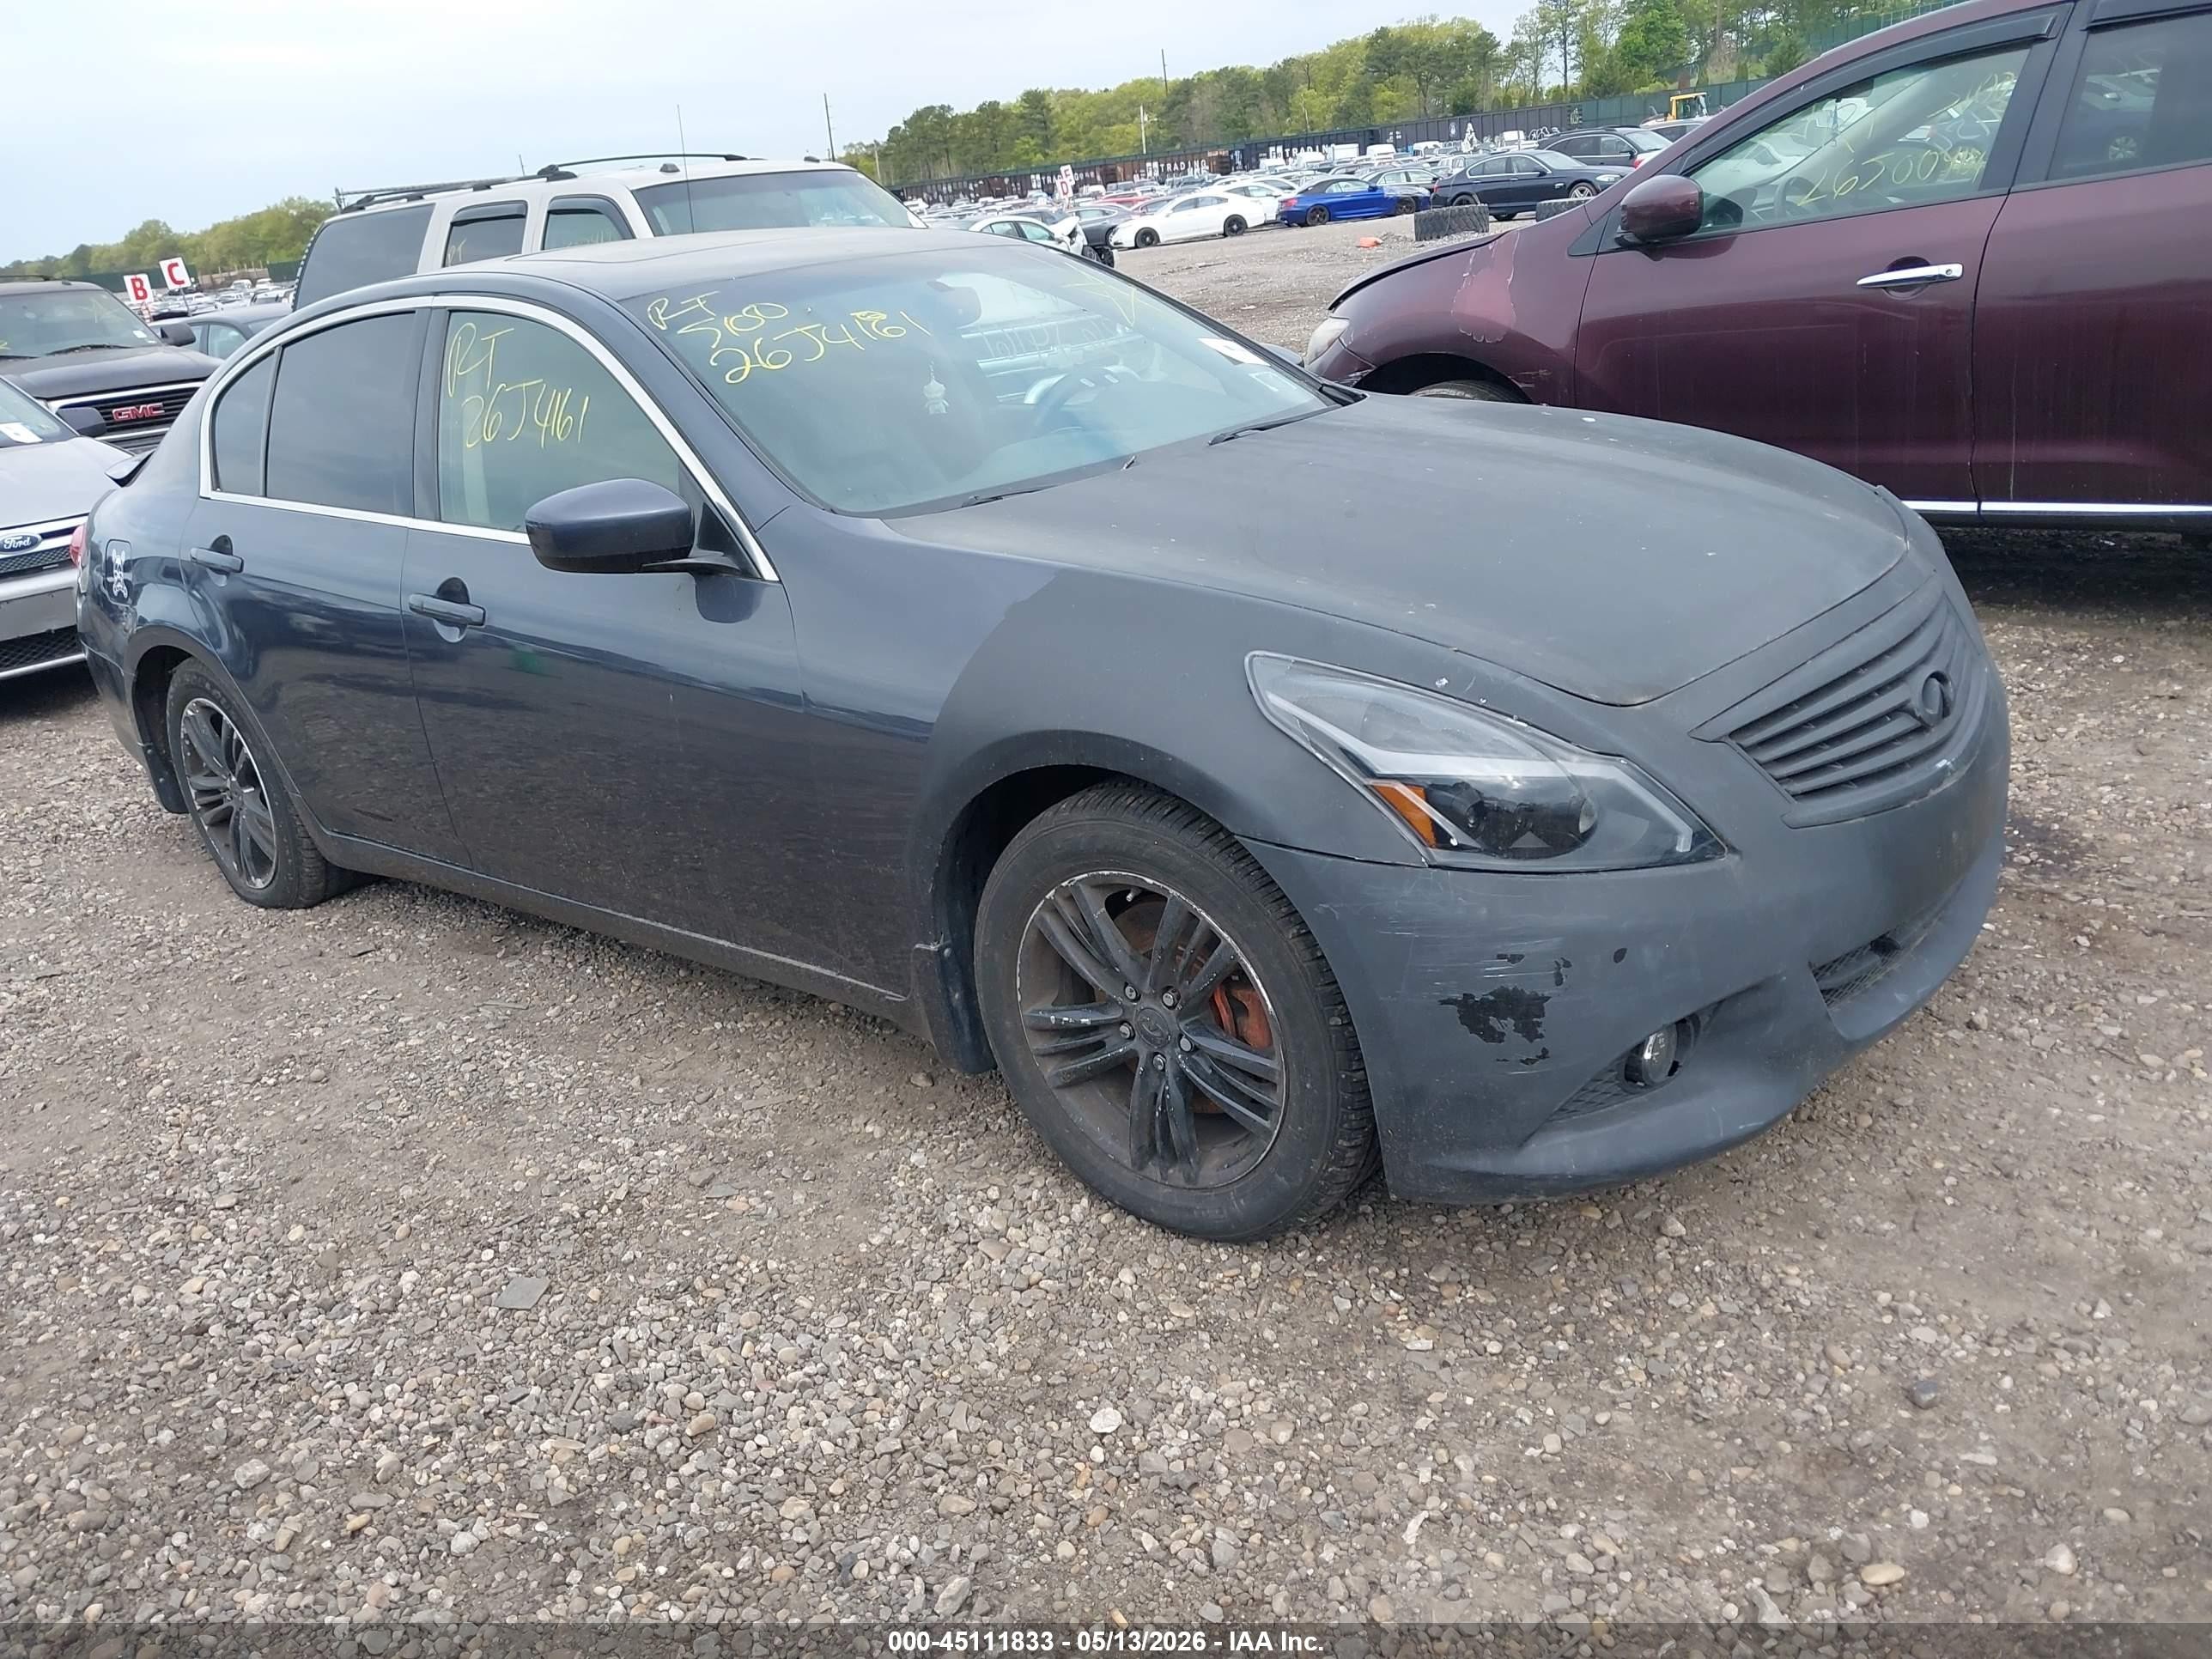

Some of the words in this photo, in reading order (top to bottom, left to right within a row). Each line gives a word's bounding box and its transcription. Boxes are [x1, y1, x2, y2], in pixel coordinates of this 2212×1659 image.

[1060, 180, 1069, 196] D
[167, 262, 185, 285] C
[131, 277, 148, 301] B
[647, 290, 720, 330] RT
[447, 322, 514, 397] RT
[112, 402, 165, 422] GMC
[461, 379, 589, 448] 26J4161
[3, 535, 32, 550] Ford
